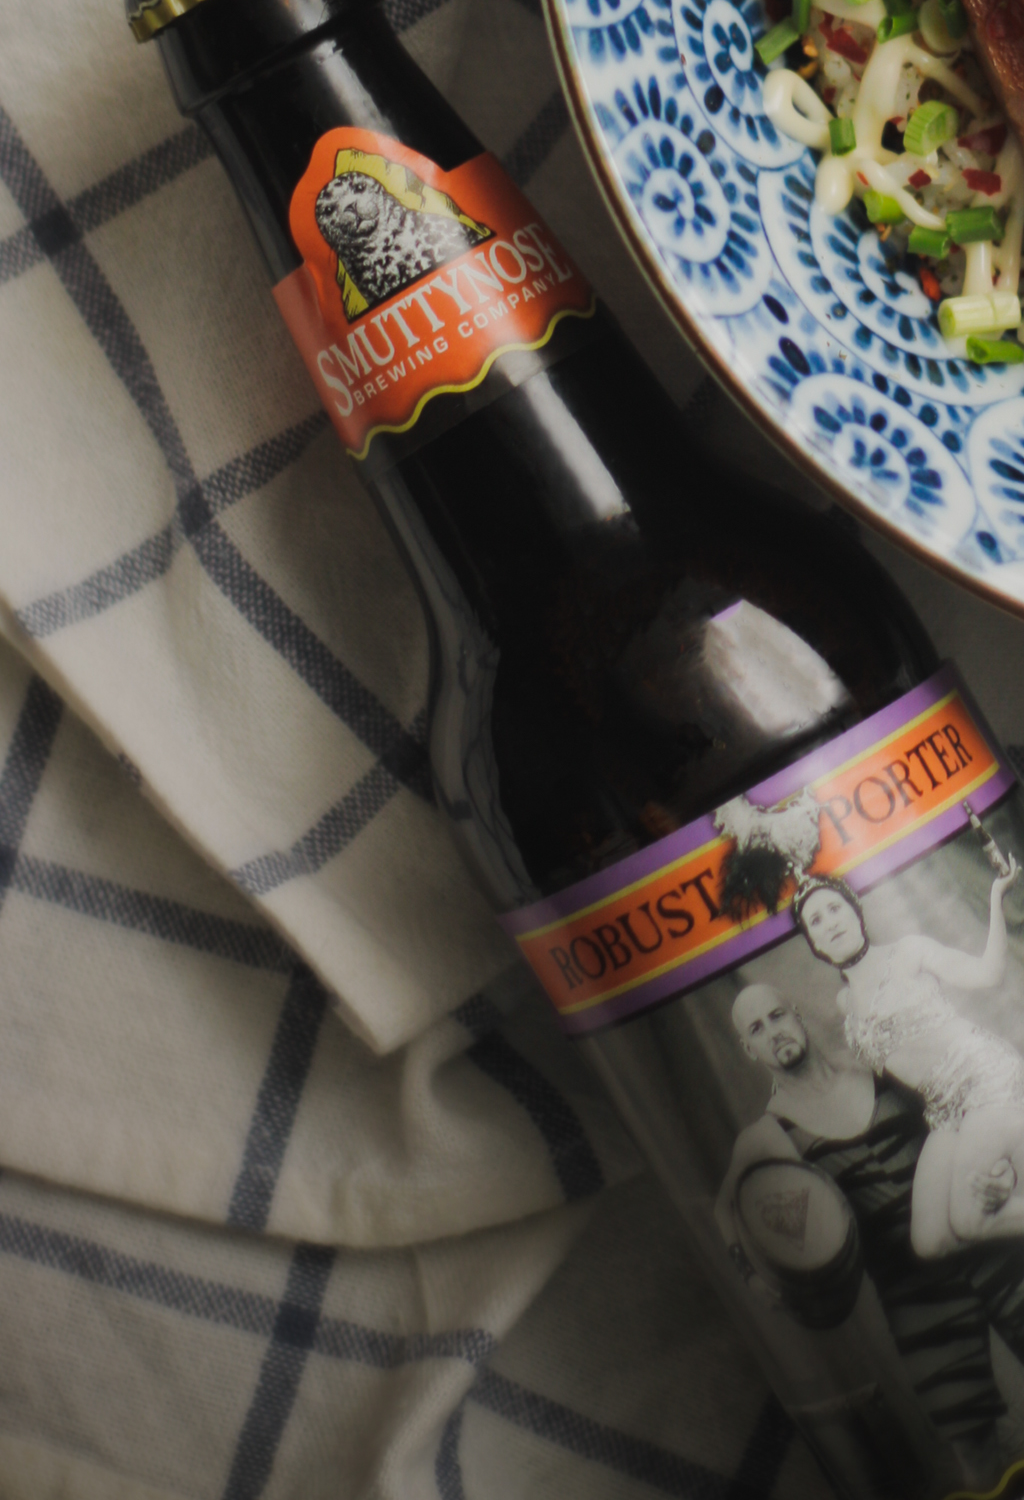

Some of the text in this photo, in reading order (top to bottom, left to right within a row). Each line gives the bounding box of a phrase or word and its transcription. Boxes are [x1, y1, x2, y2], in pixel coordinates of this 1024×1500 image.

[316, 222, 572, 418] SMUTTYNOSE
[353, 273, 557, 407] BREWING COMPANY
[549, 721, 974, 990] ROBUST PORTER
